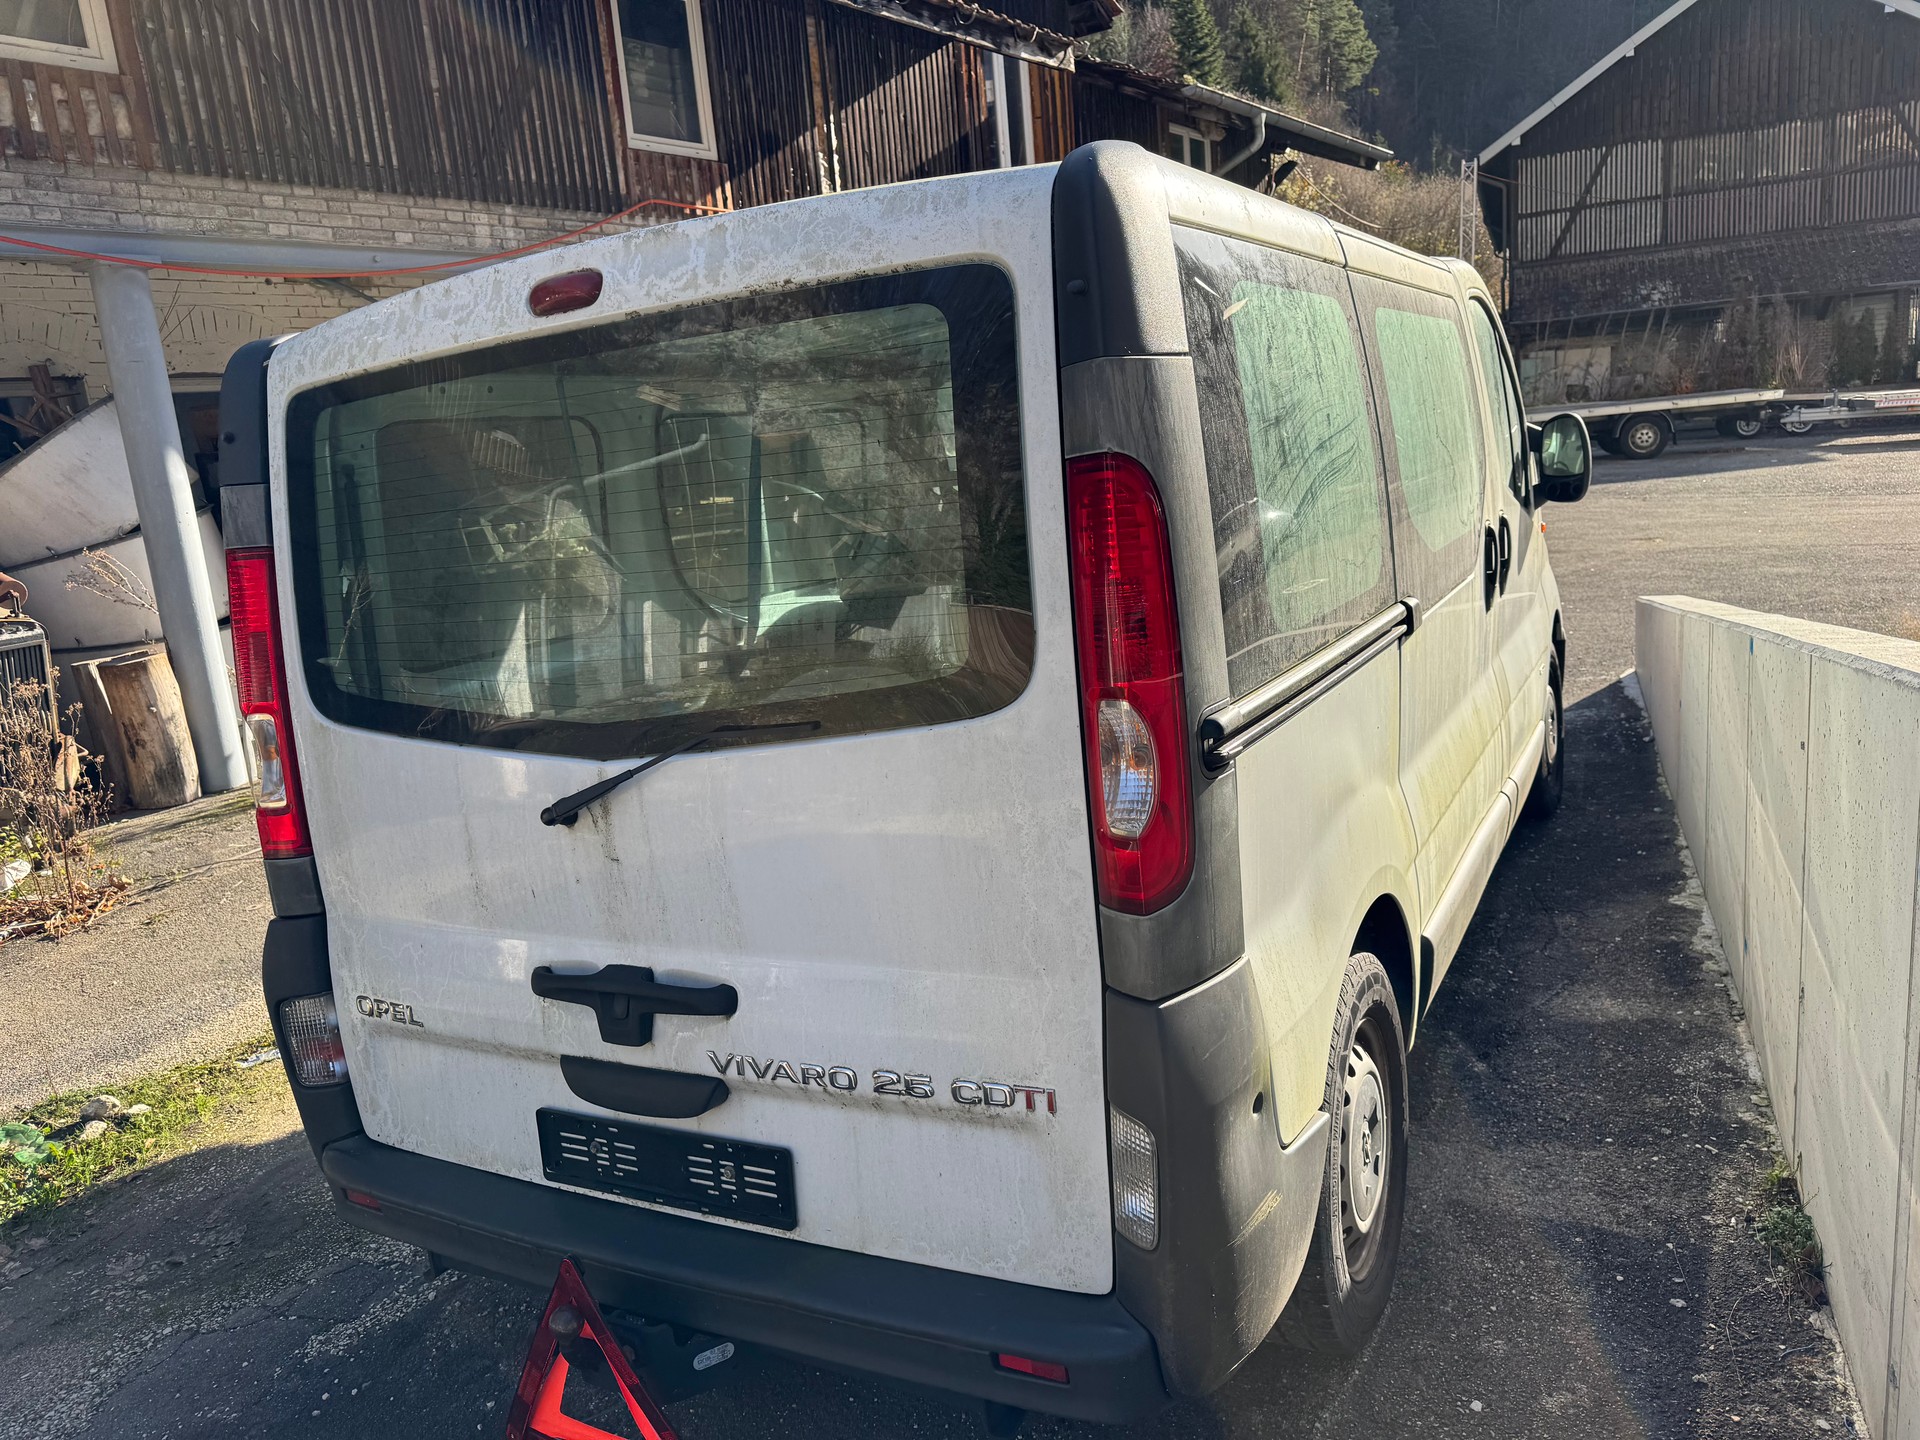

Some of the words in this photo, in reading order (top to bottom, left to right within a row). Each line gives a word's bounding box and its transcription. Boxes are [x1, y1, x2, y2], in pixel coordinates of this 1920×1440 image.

[356, 995, 424, 1028] OPEL
[706, 1050, 858, 1091] VIVARO
[951, 1078, 1057, 1114] CDTI
